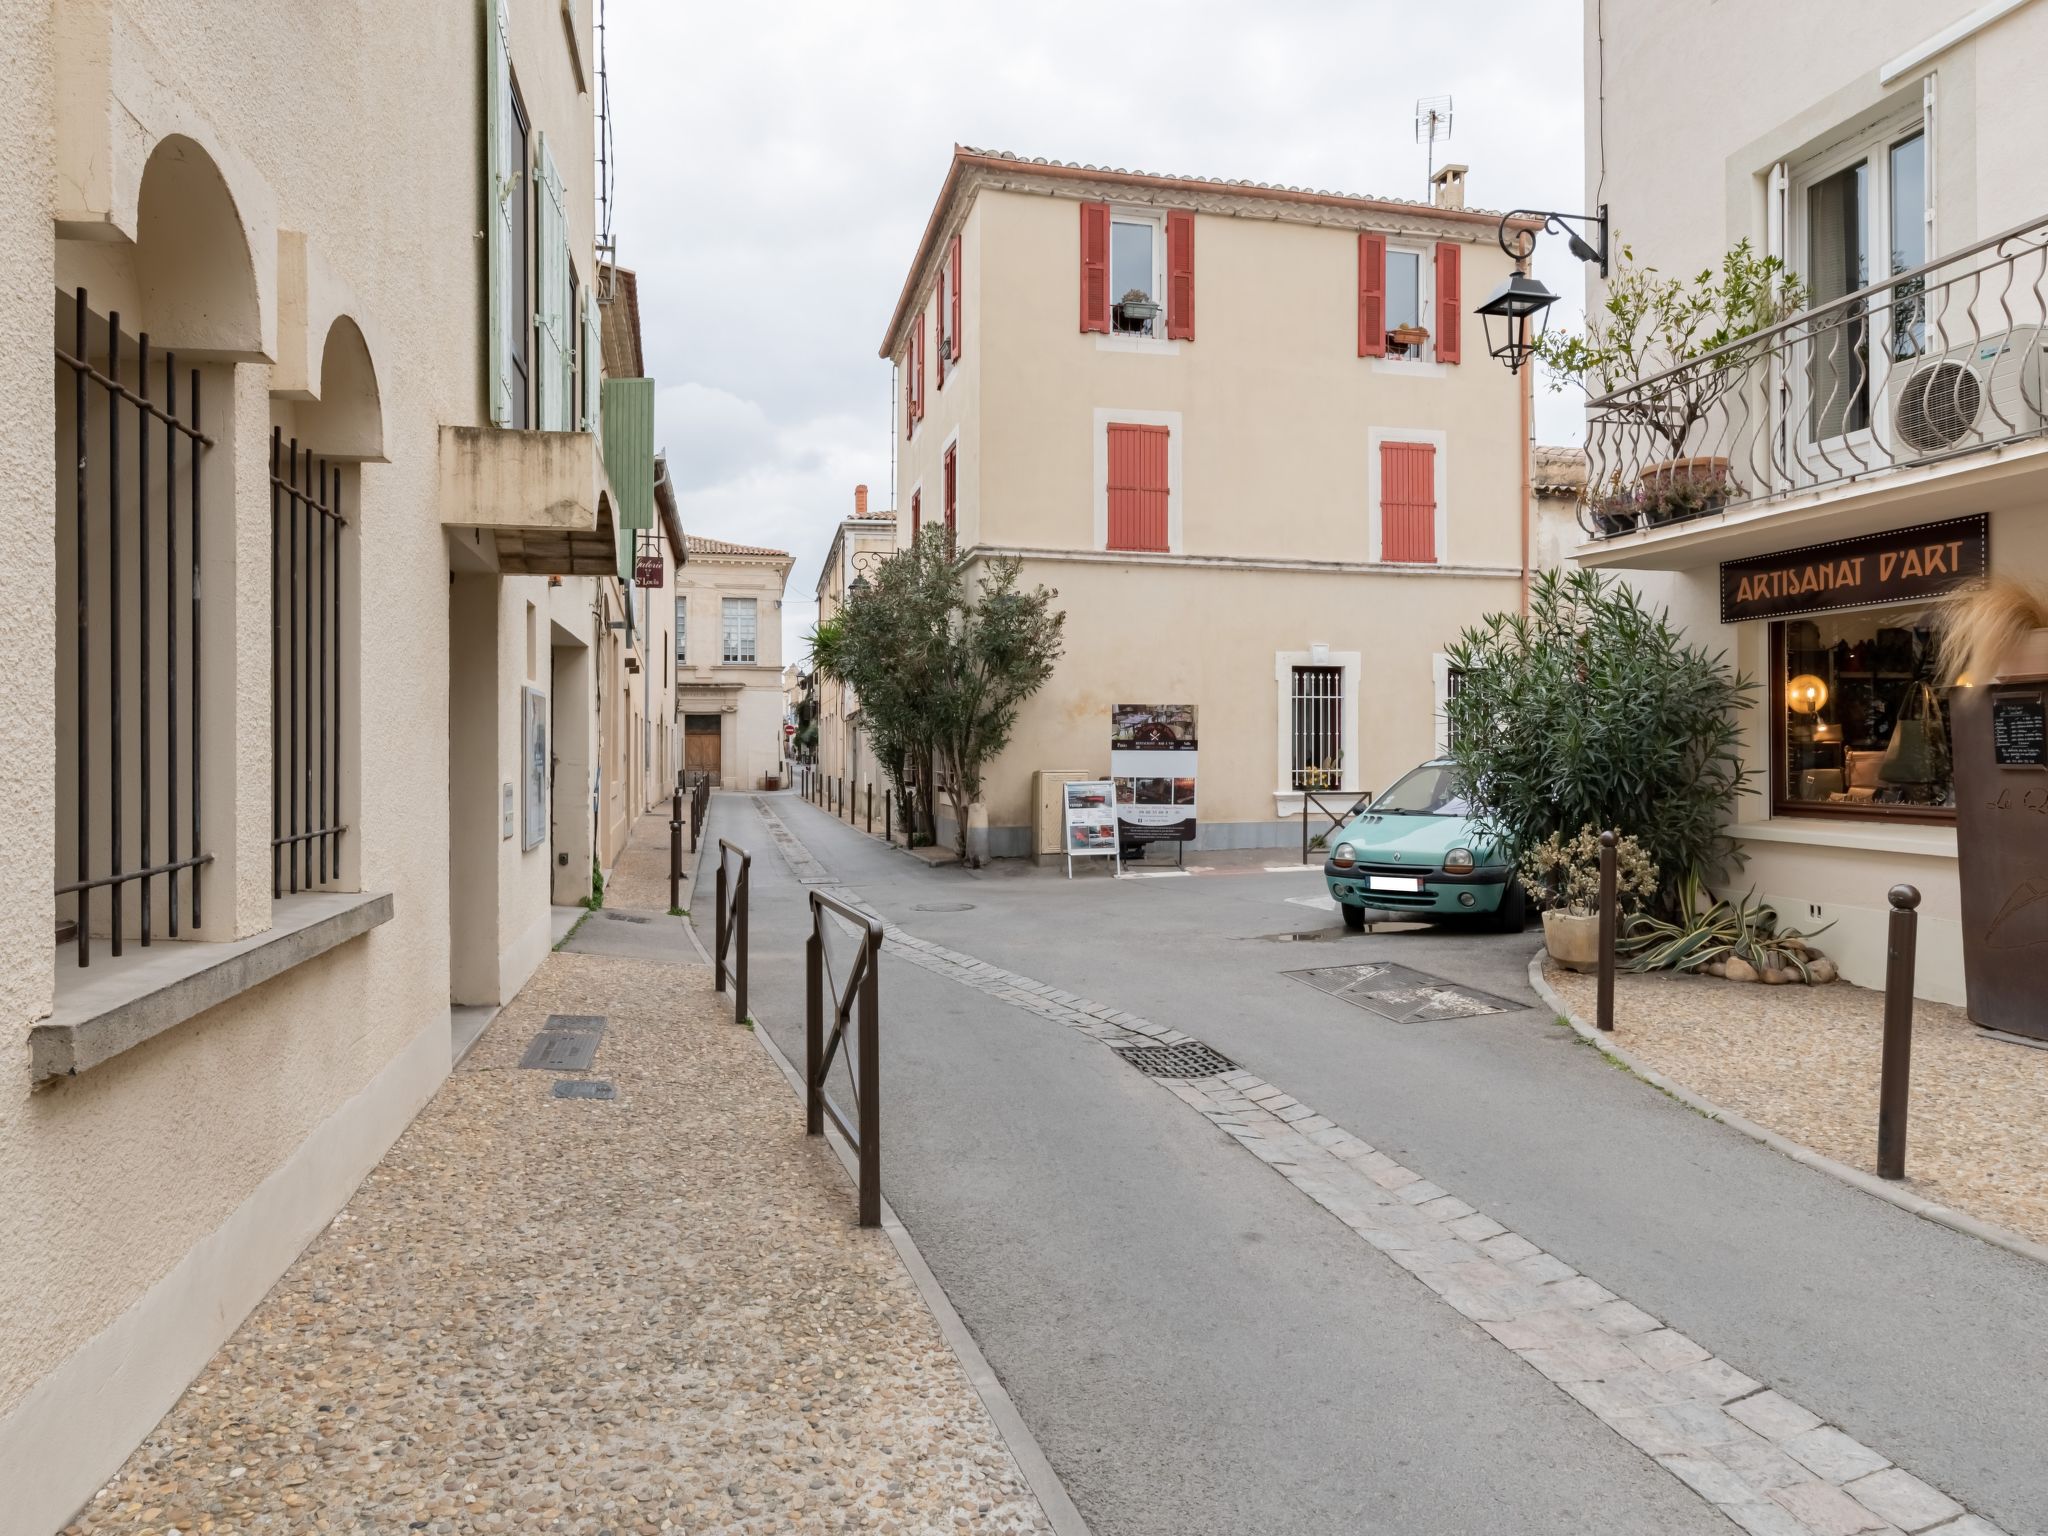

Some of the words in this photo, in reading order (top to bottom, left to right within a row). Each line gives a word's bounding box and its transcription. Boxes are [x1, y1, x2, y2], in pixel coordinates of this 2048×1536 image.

[636, 557, 663, 569] Galerie
[1736, 557, 1865, 603] ARTISANAT
[1879, 541, 1964, 582] D'ART
[642, 576, 660, 586] Louis
